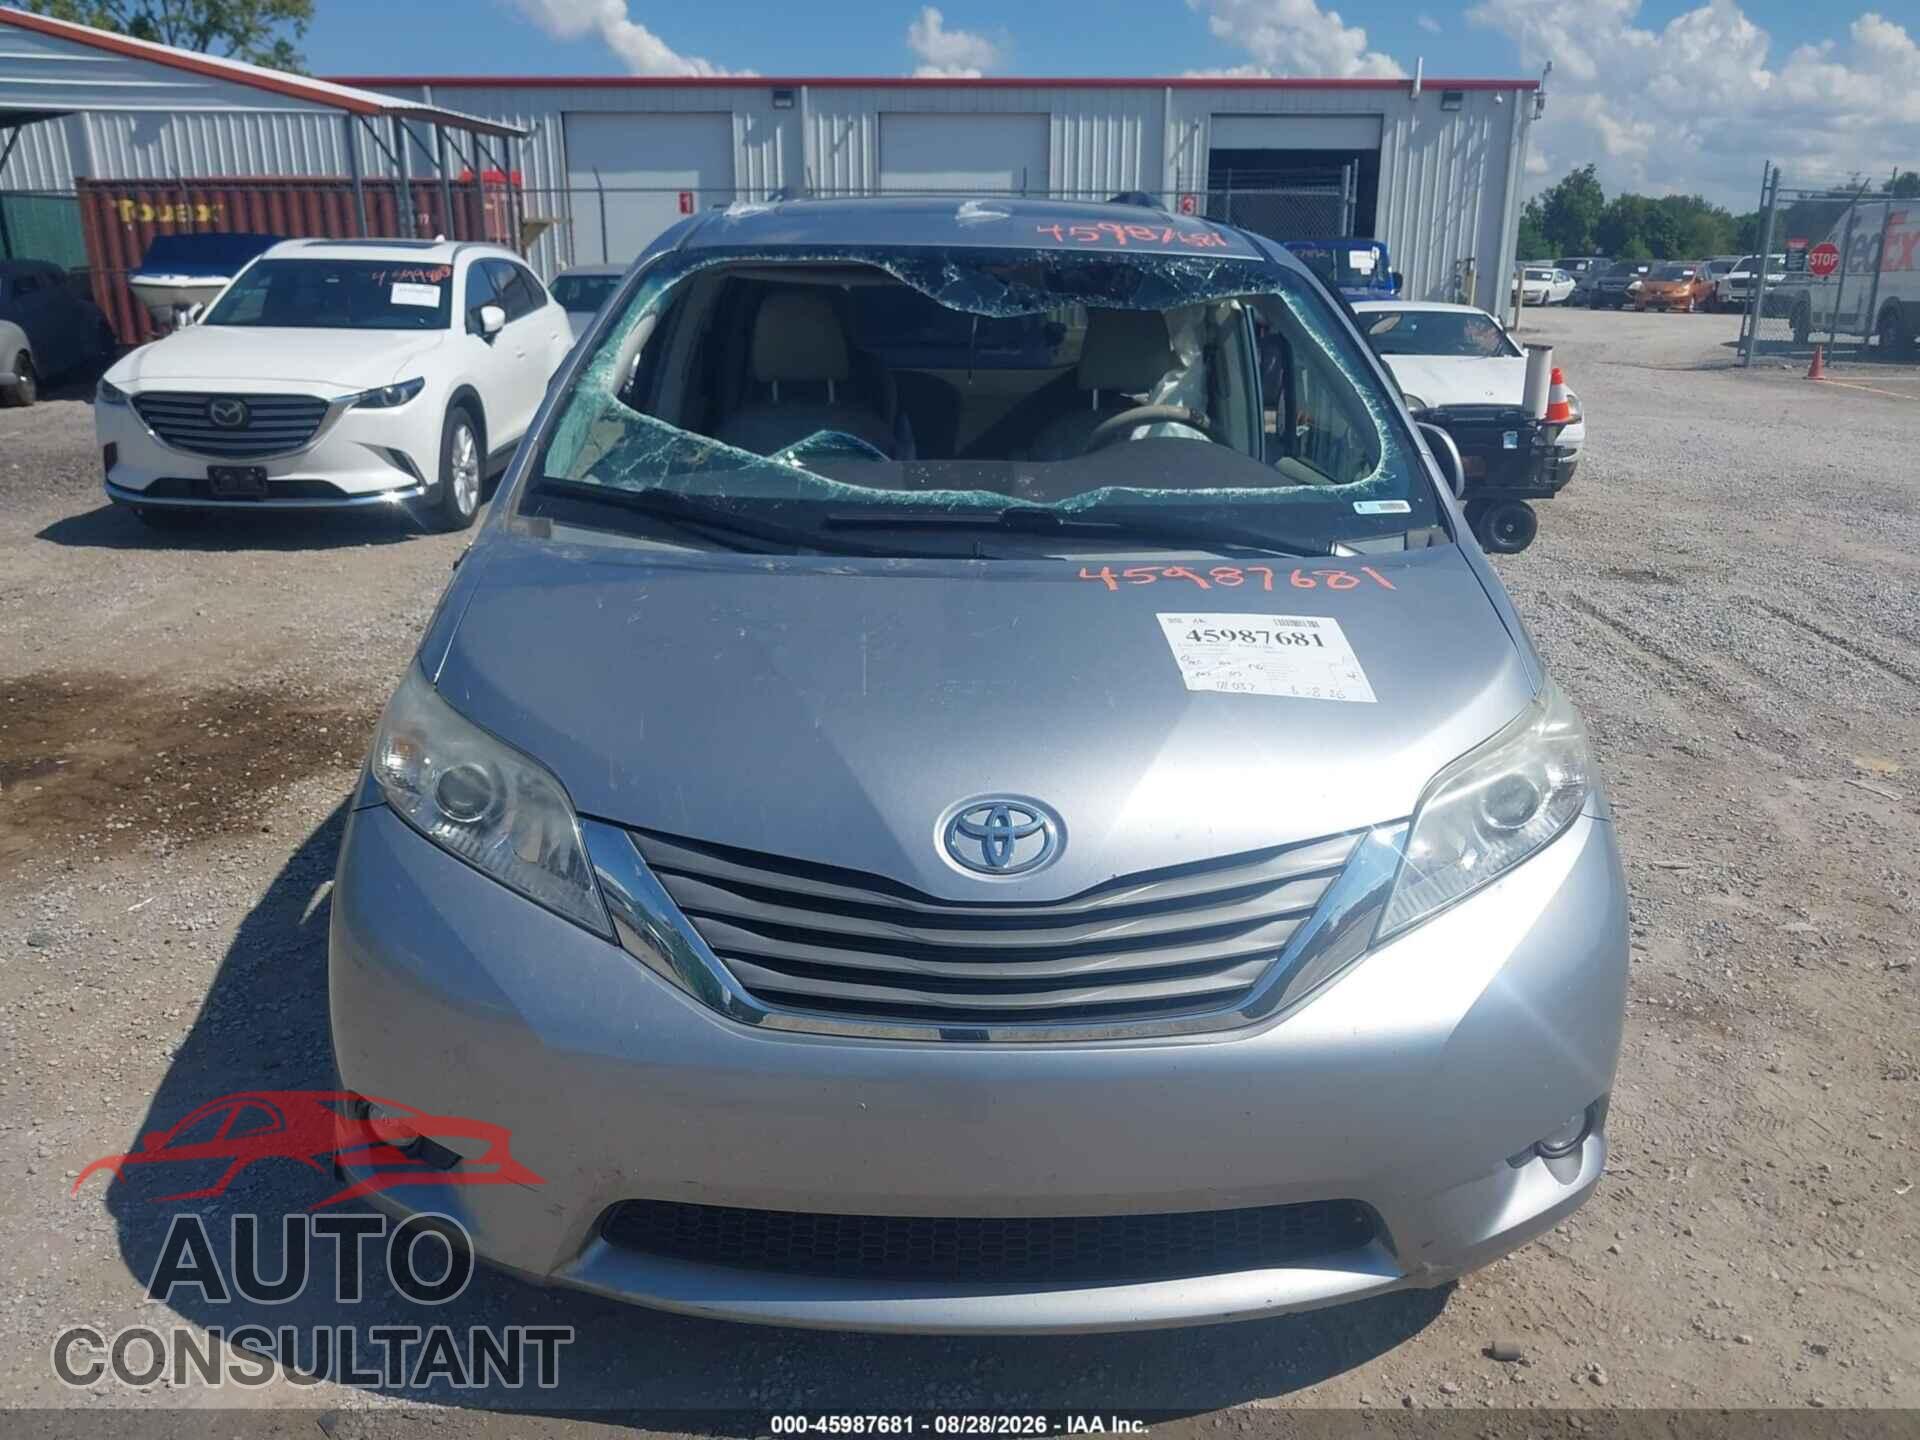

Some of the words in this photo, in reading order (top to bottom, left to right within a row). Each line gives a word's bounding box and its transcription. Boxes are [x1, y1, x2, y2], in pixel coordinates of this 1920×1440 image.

[1810, 253, 1839, 266] STOP
[1079, 565, 1397, 592] 45987681
[1185, 628, 1326, 648] 45987681
